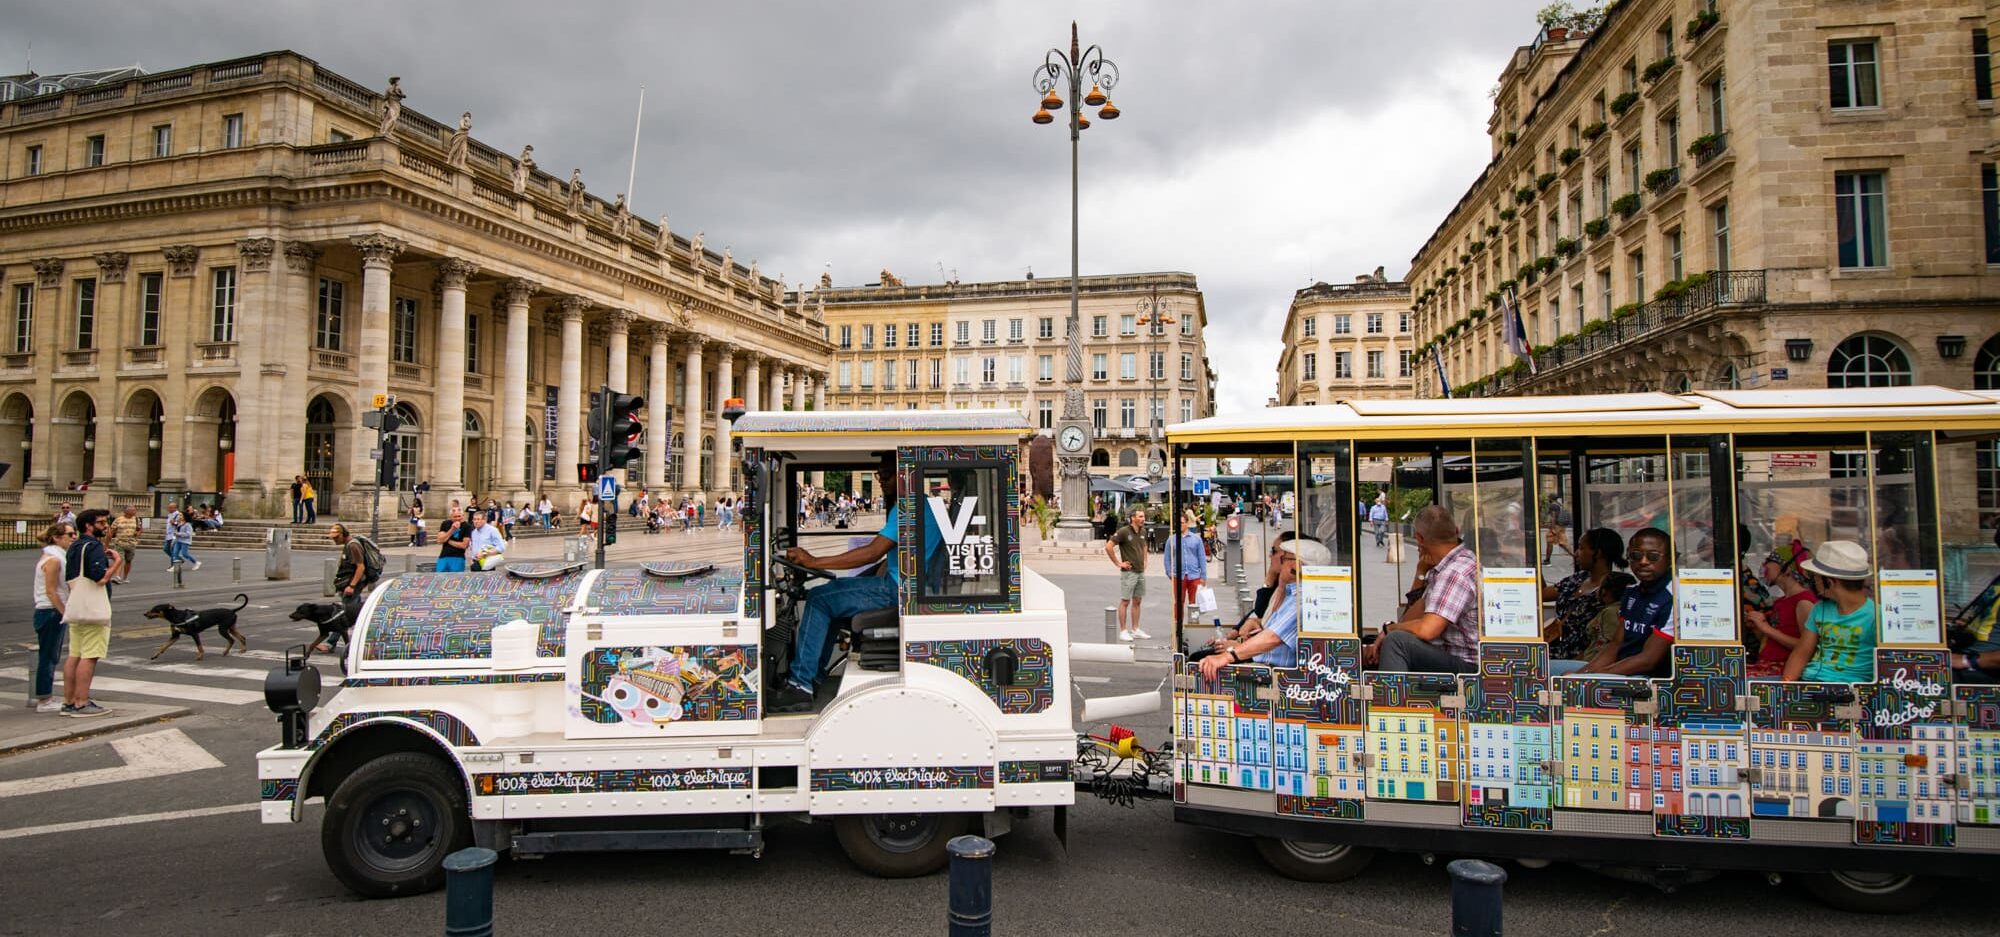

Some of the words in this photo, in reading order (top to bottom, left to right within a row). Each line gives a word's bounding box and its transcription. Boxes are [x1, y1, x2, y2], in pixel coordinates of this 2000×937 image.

[946, 544, 993, 556] VISITE
[949, 555, 993, 570] ECO
[496, 776, 528, 791] 100%
[530, 772, 595, 793] électrique
[649, 773, 681, 788] 100%
[683, 769, 747, 790] électrique
[849, 770, 882, 784] 100%
[884, 768, 949, 788] électrique
